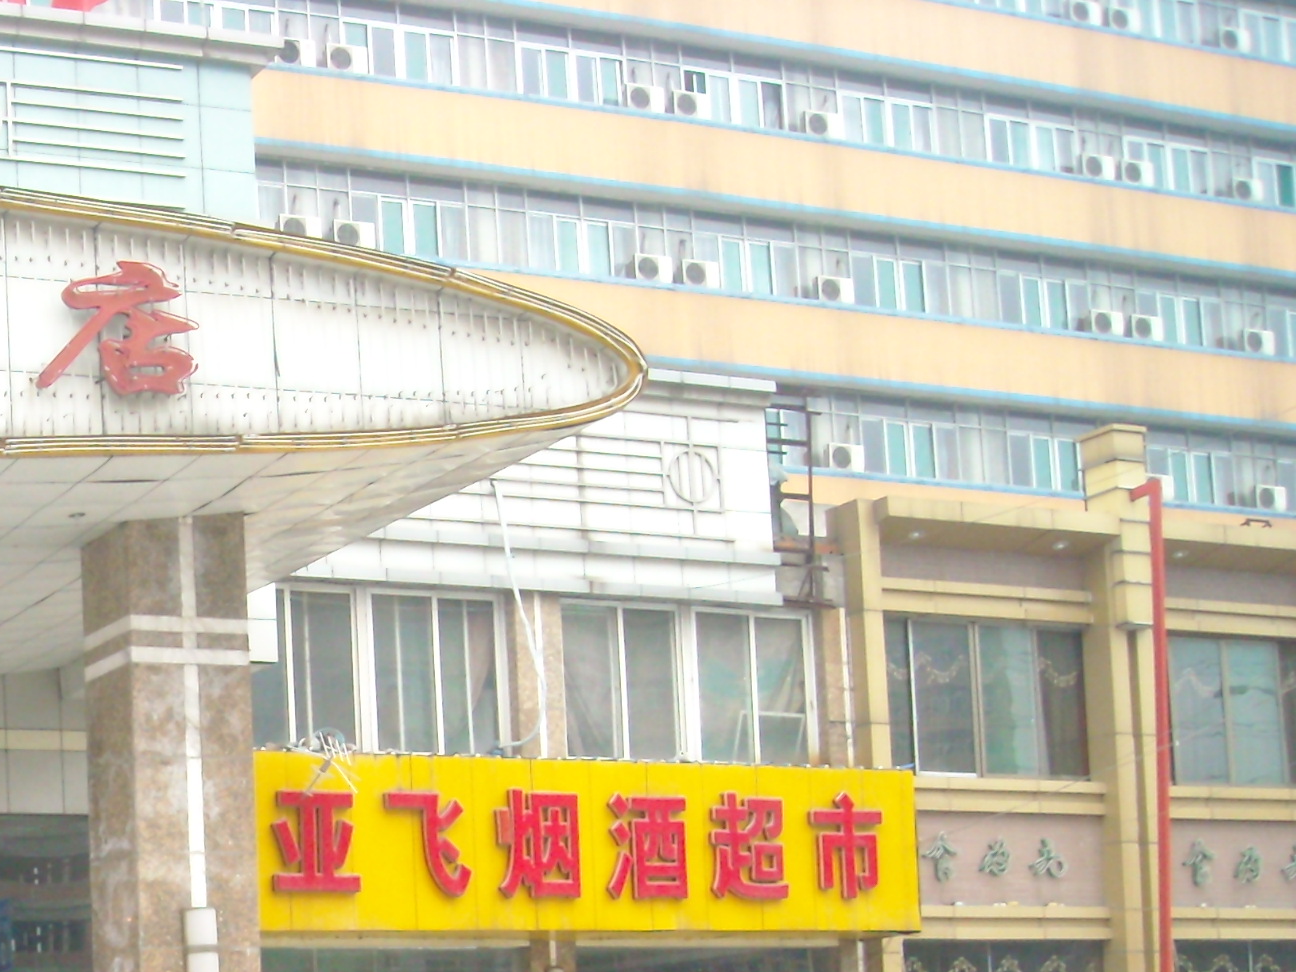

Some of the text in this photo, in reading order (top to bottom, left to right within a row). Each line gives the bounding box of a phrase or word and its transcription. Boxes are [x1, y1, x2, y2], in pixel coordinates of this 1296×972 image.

[270, 787, 884, 903] 亚飞烟酒超市
